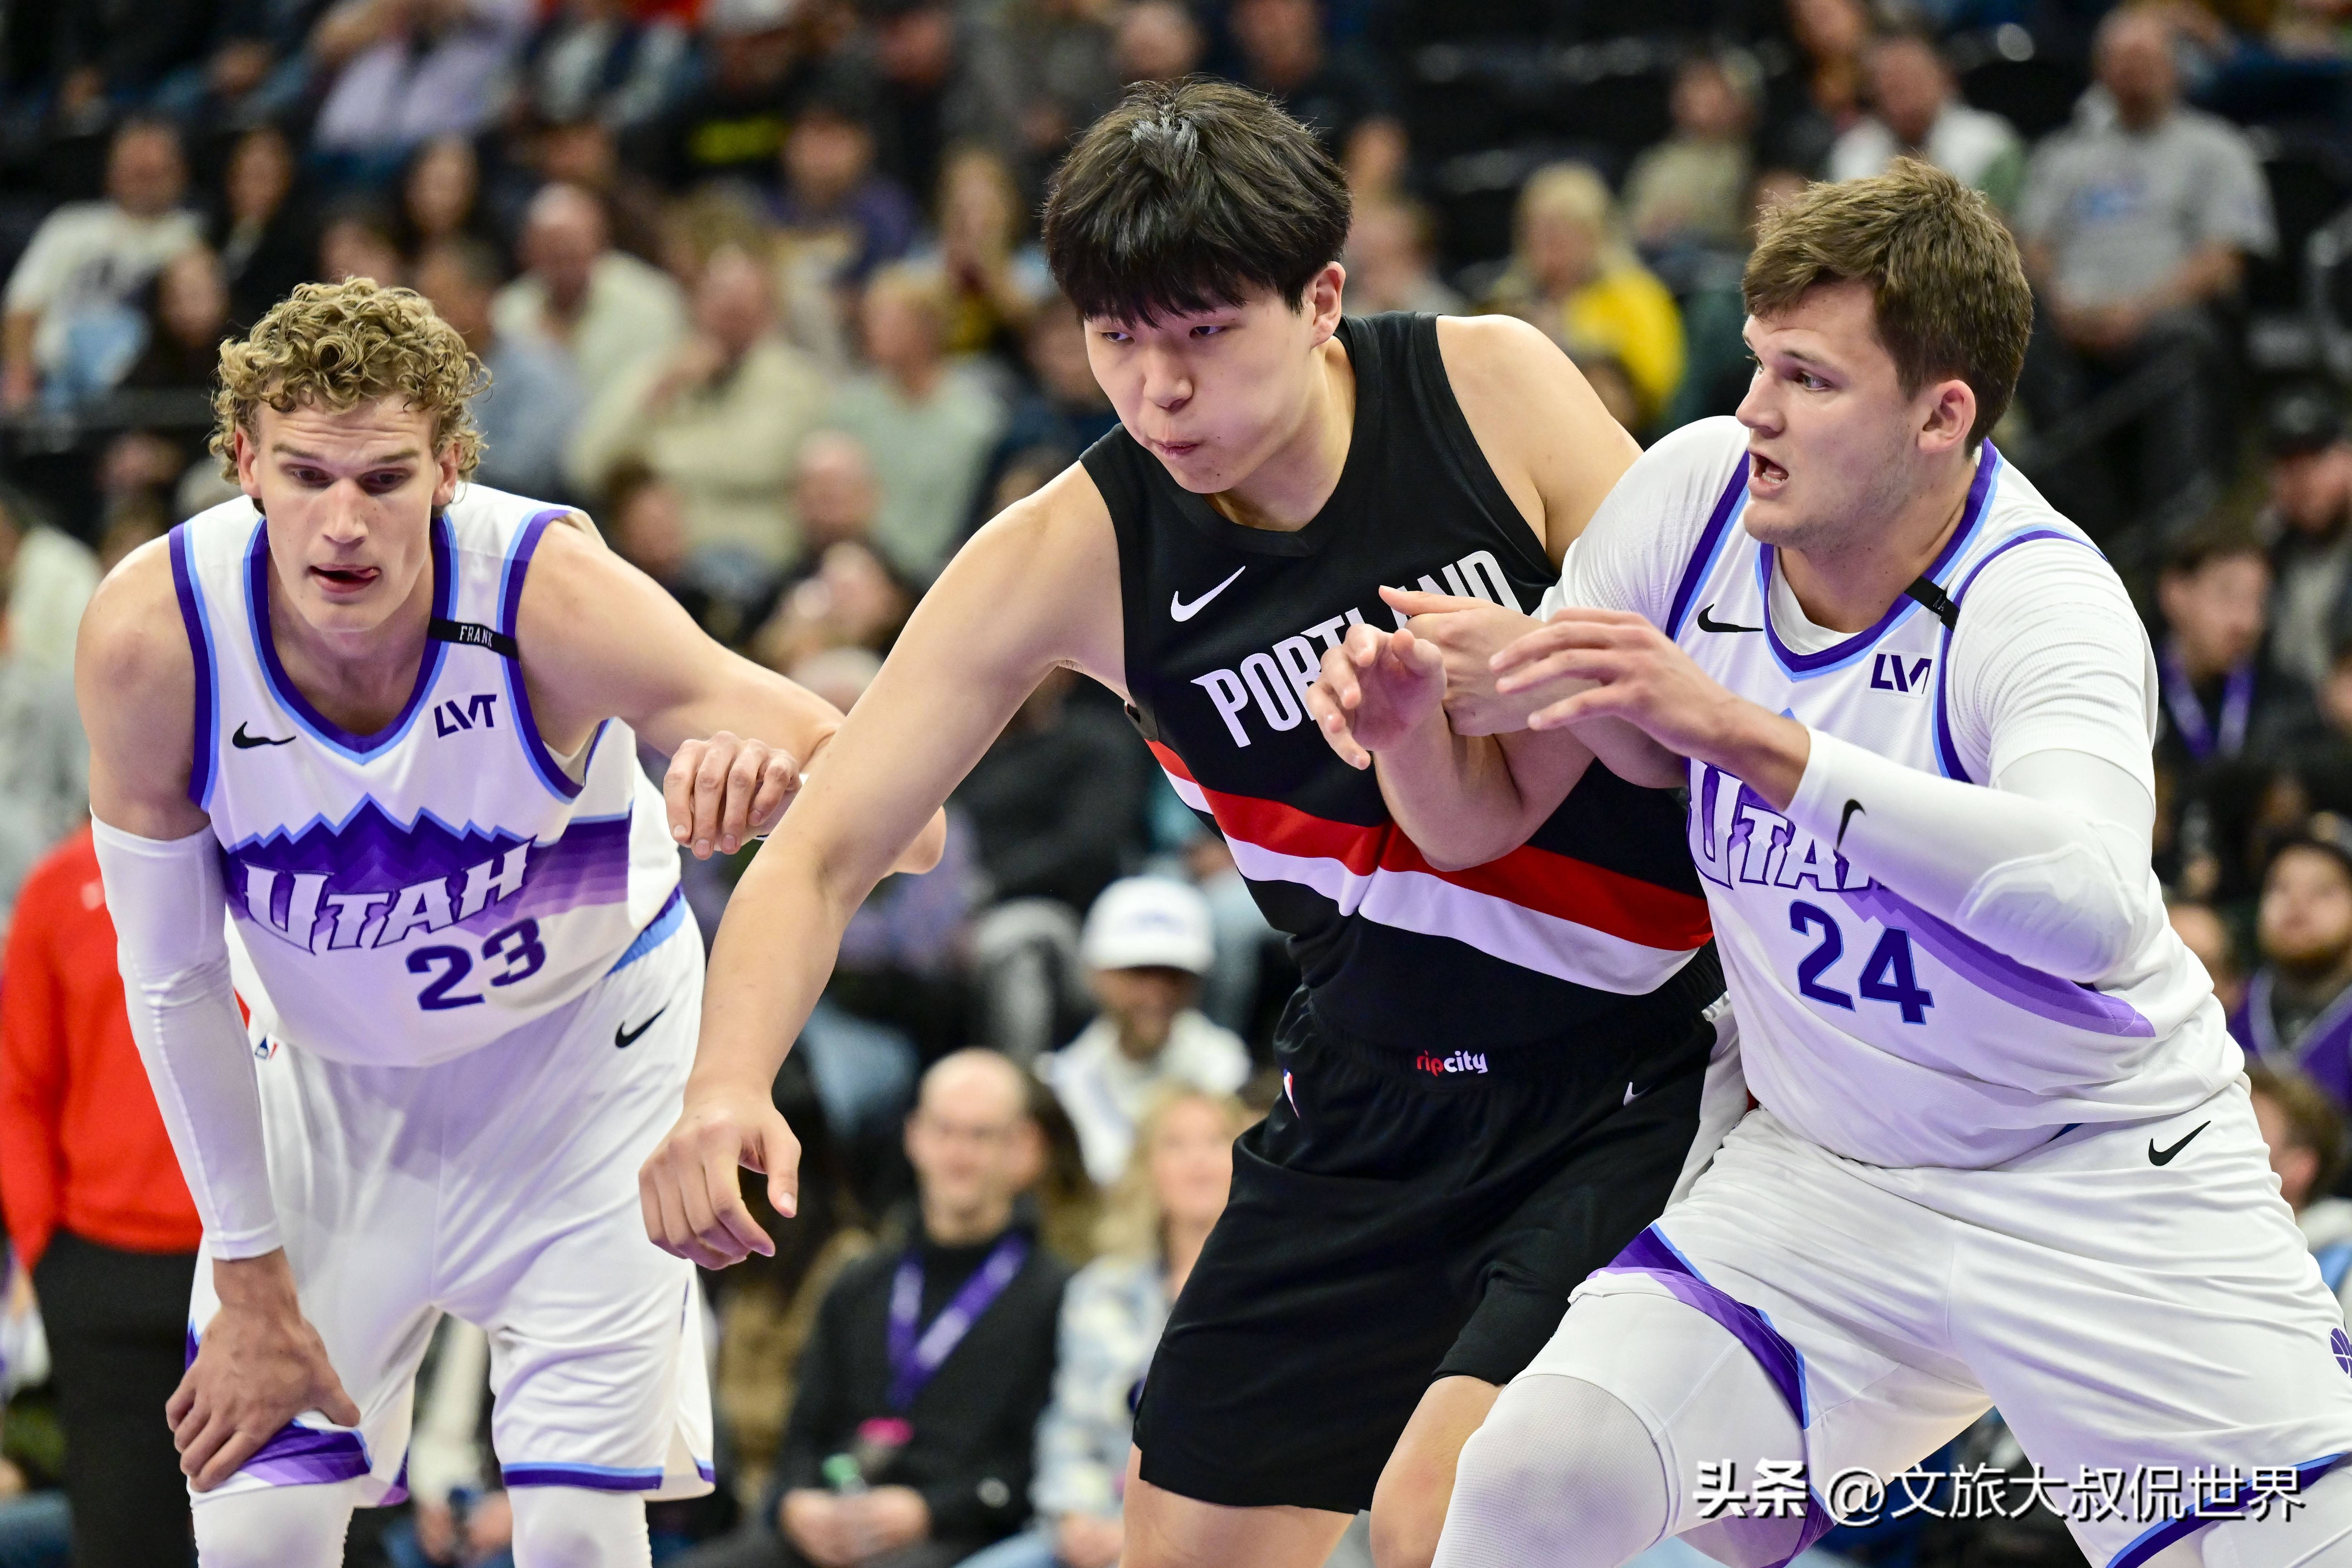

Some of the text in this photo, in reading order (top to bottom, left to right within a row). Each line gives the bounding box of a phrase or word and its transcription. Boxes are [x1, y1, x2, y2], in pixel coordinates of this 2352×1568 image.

[459, 625, 493, 648] FRANK
[434, 694, 497, 738] LVT
[1687, 757, 1885, 892] UTA
[241, 835, 537, 955] UTAH
[406, 917, 546, 1011] 23
[1789, 899, 1934, 1025] 24
[1416, 1050, 1488, 1076] ripcity
